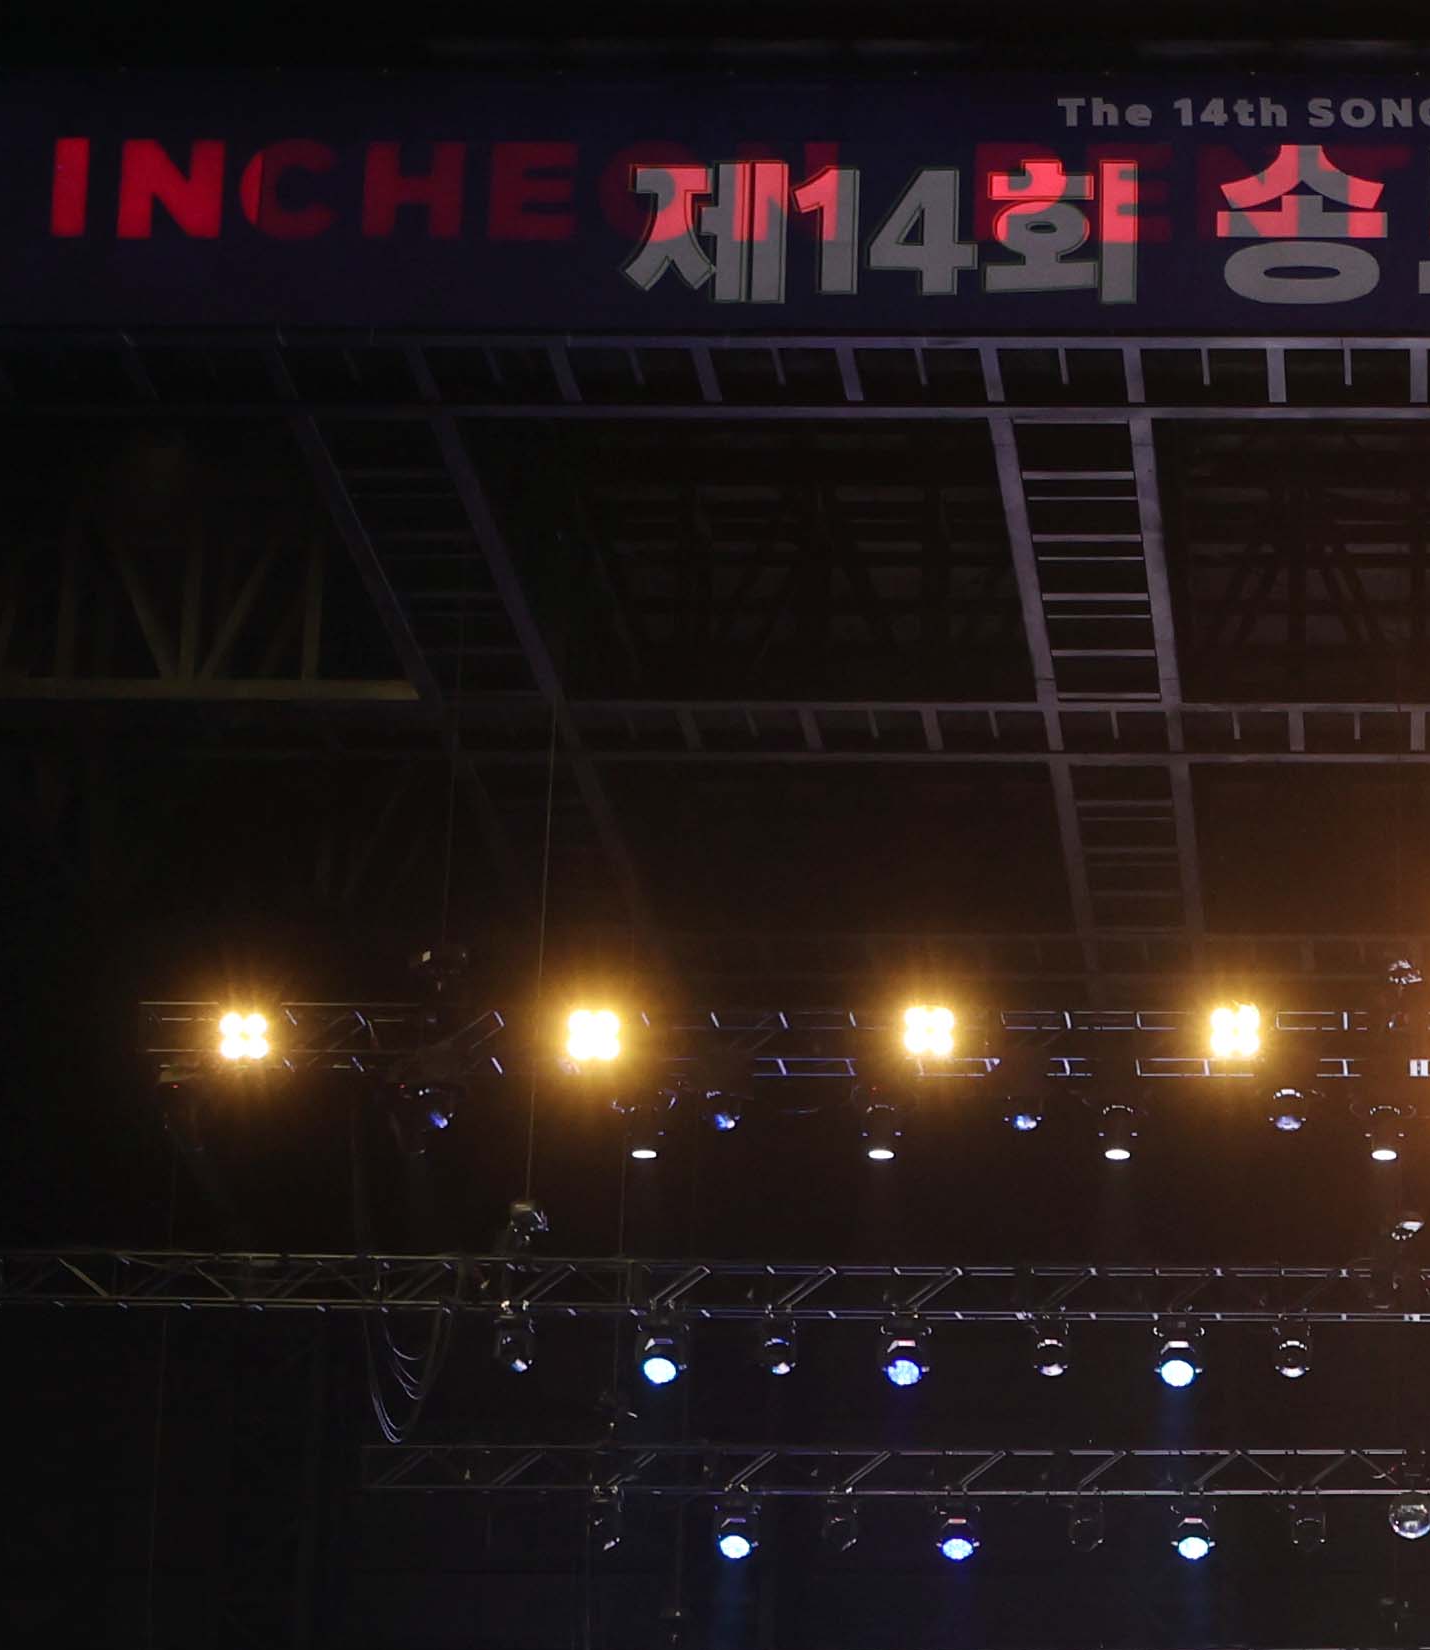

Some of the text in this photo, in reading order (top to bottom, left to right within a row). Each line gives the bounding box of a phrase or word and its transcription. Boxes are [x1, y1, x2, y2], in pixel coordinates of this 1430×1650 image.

[1056, 97, 1152, 128] The
[1179, 97, 1289, 128] 14th
[50, 136, 841, 243] INCHEON
[620, 160, 1138, 303] 제14회
